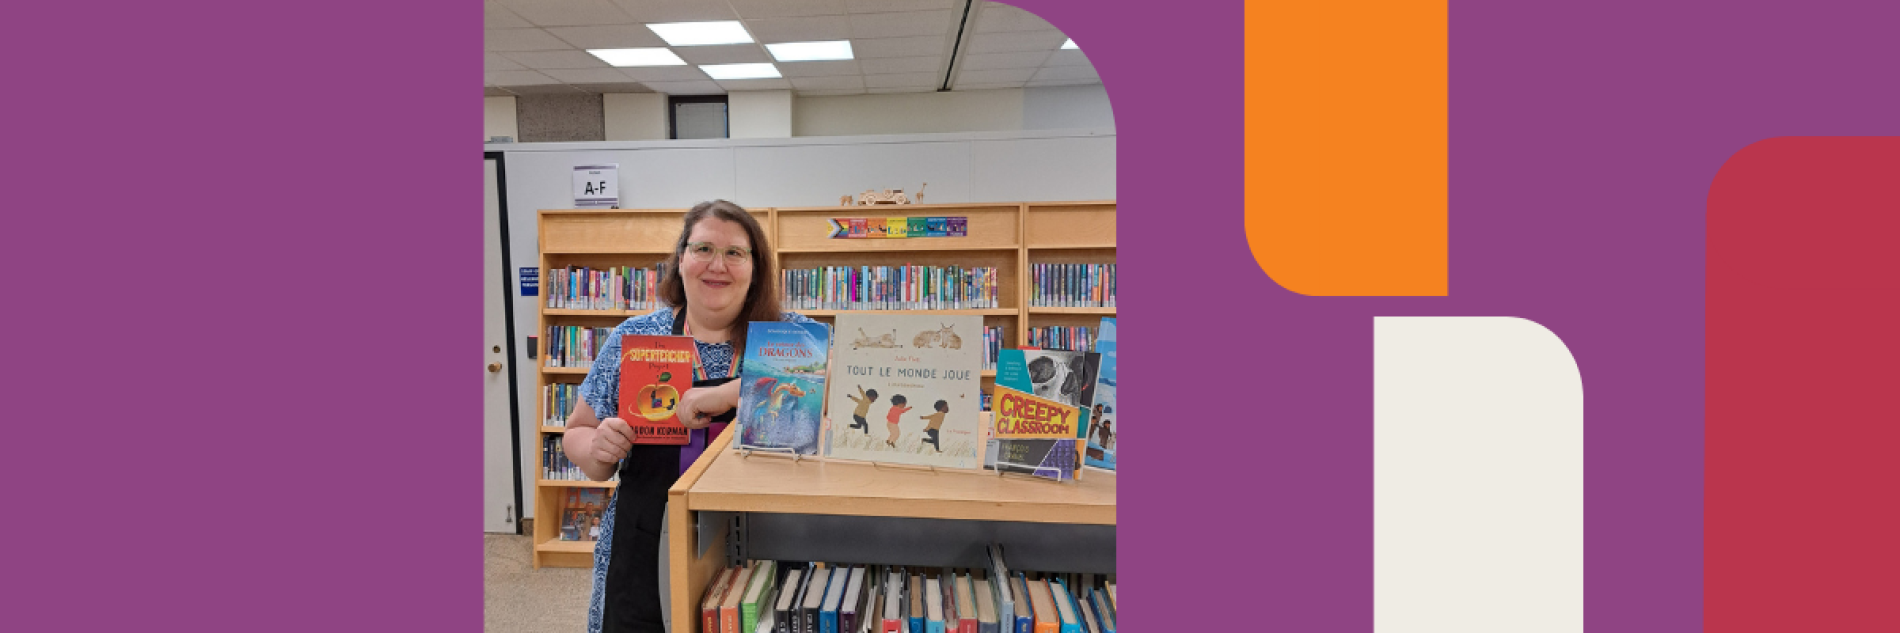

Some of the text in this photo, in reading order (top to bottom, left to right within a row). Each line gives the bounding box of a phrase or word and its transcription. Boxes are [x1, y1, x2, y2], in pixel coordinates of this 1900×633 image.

[584, 181, 606, 195] A-F
[630, 349, 691, 363] SUPERTEACHER
[758, 347, 813, 358] DRAGONS
[847, 365, 971, 381] TOUT LE MONDE JOUE
[1000, 393, 1071, 424] CREEPY
[997, 417, 1070, 435] CLASSROOM
